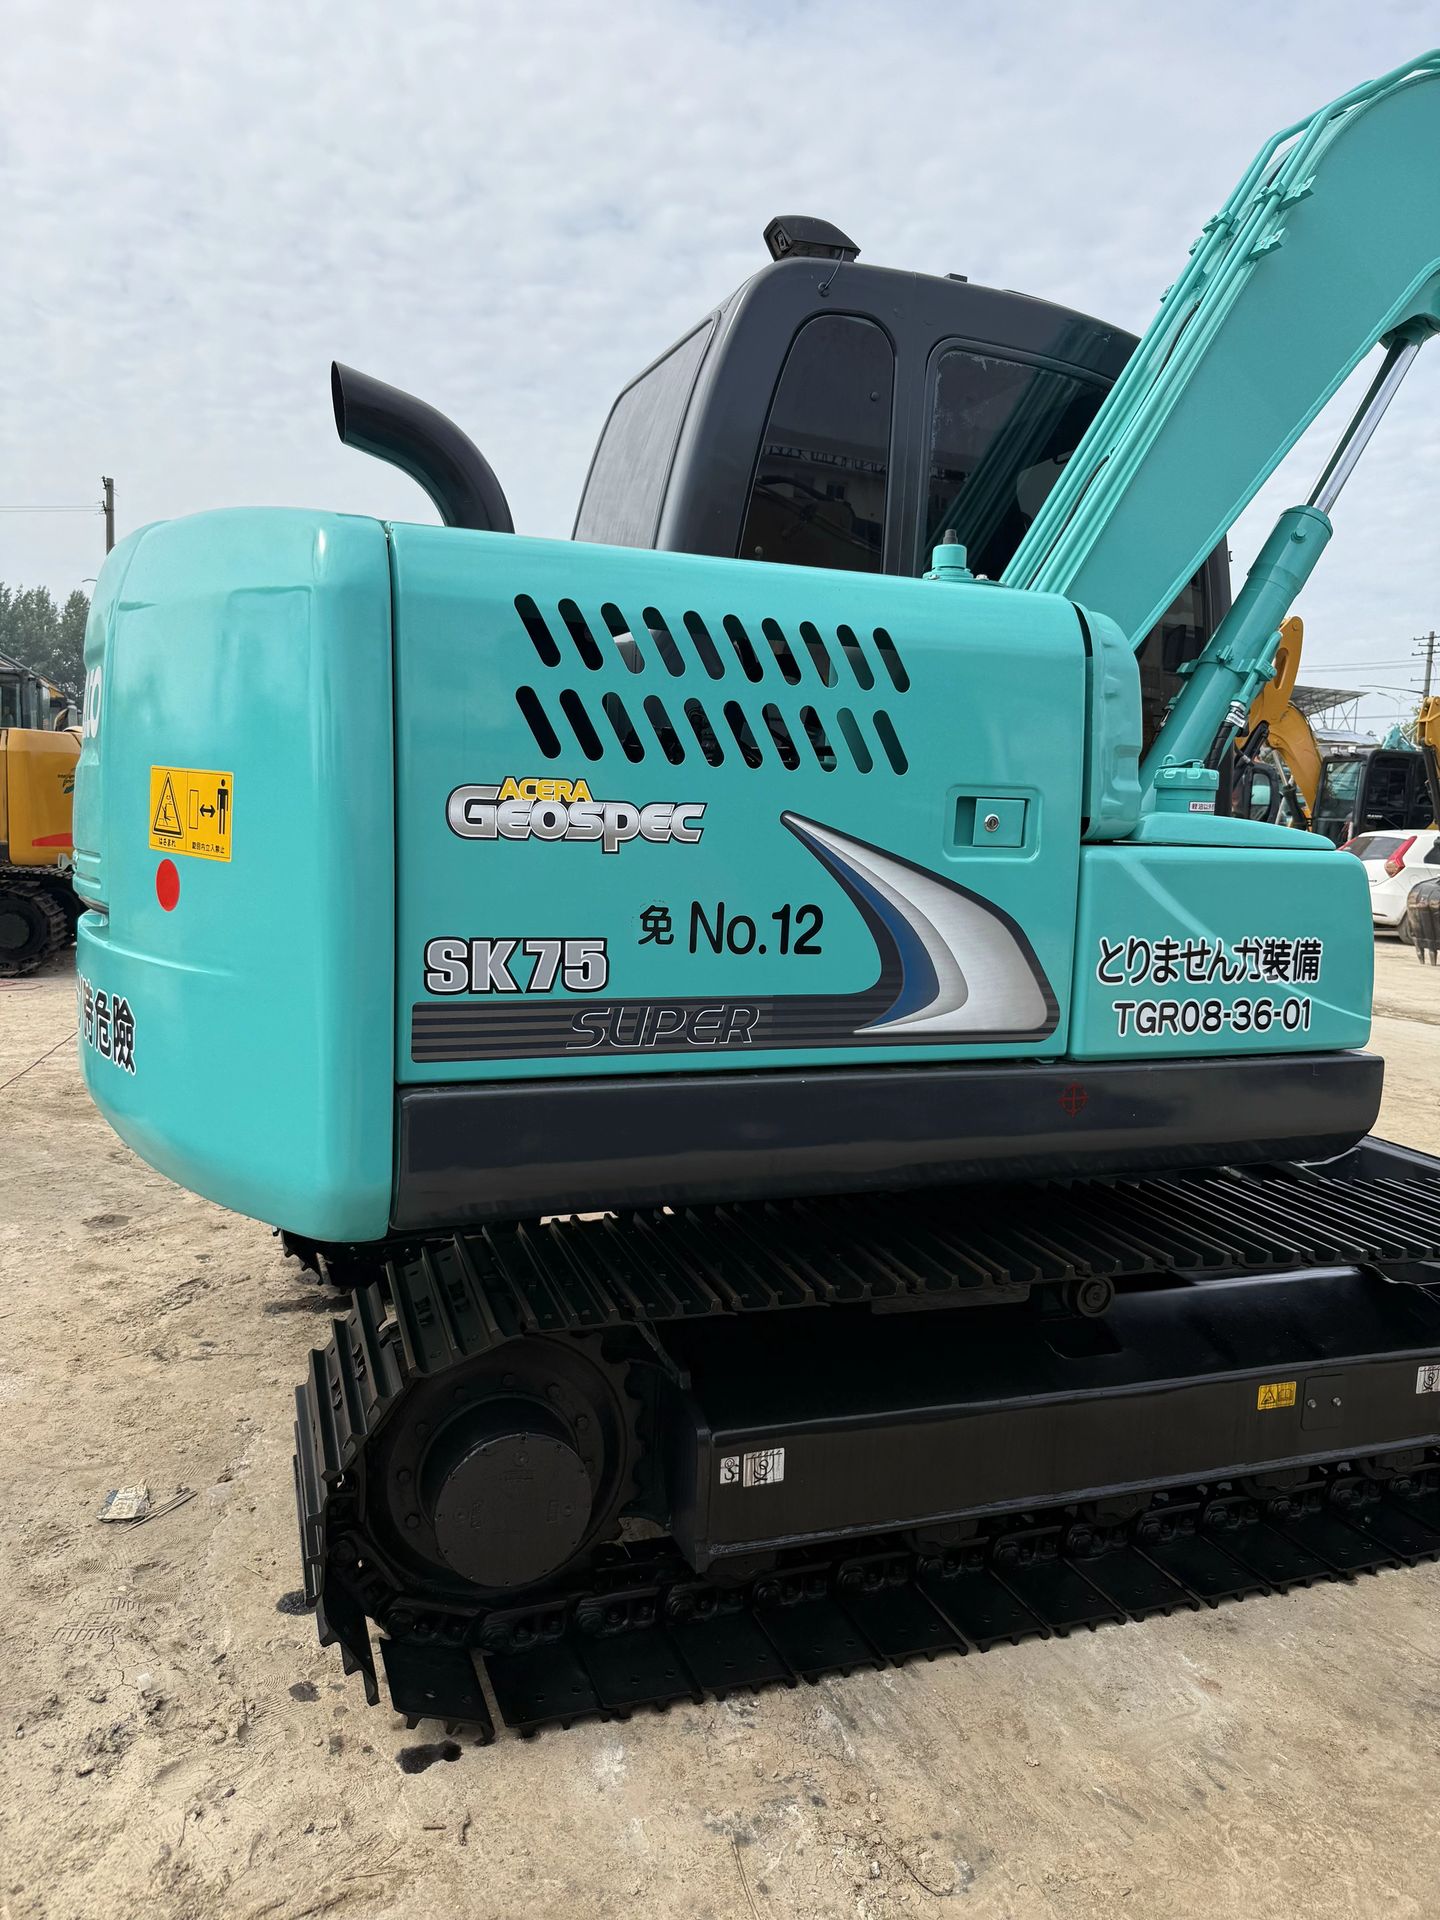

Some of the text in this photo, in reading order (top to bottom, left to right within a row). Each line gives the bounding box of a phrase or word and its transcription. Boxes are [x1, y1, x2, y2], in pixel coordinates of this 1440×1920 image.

[497, 777, 594, 803] ACERA
[638, 901, 823, 956] 免 No.12
[423, 937, 609, 994] SK75
[566, 1004, 760, 1050] SUPER
[1112, 996, 1312, 1037] TGR08-36-01
